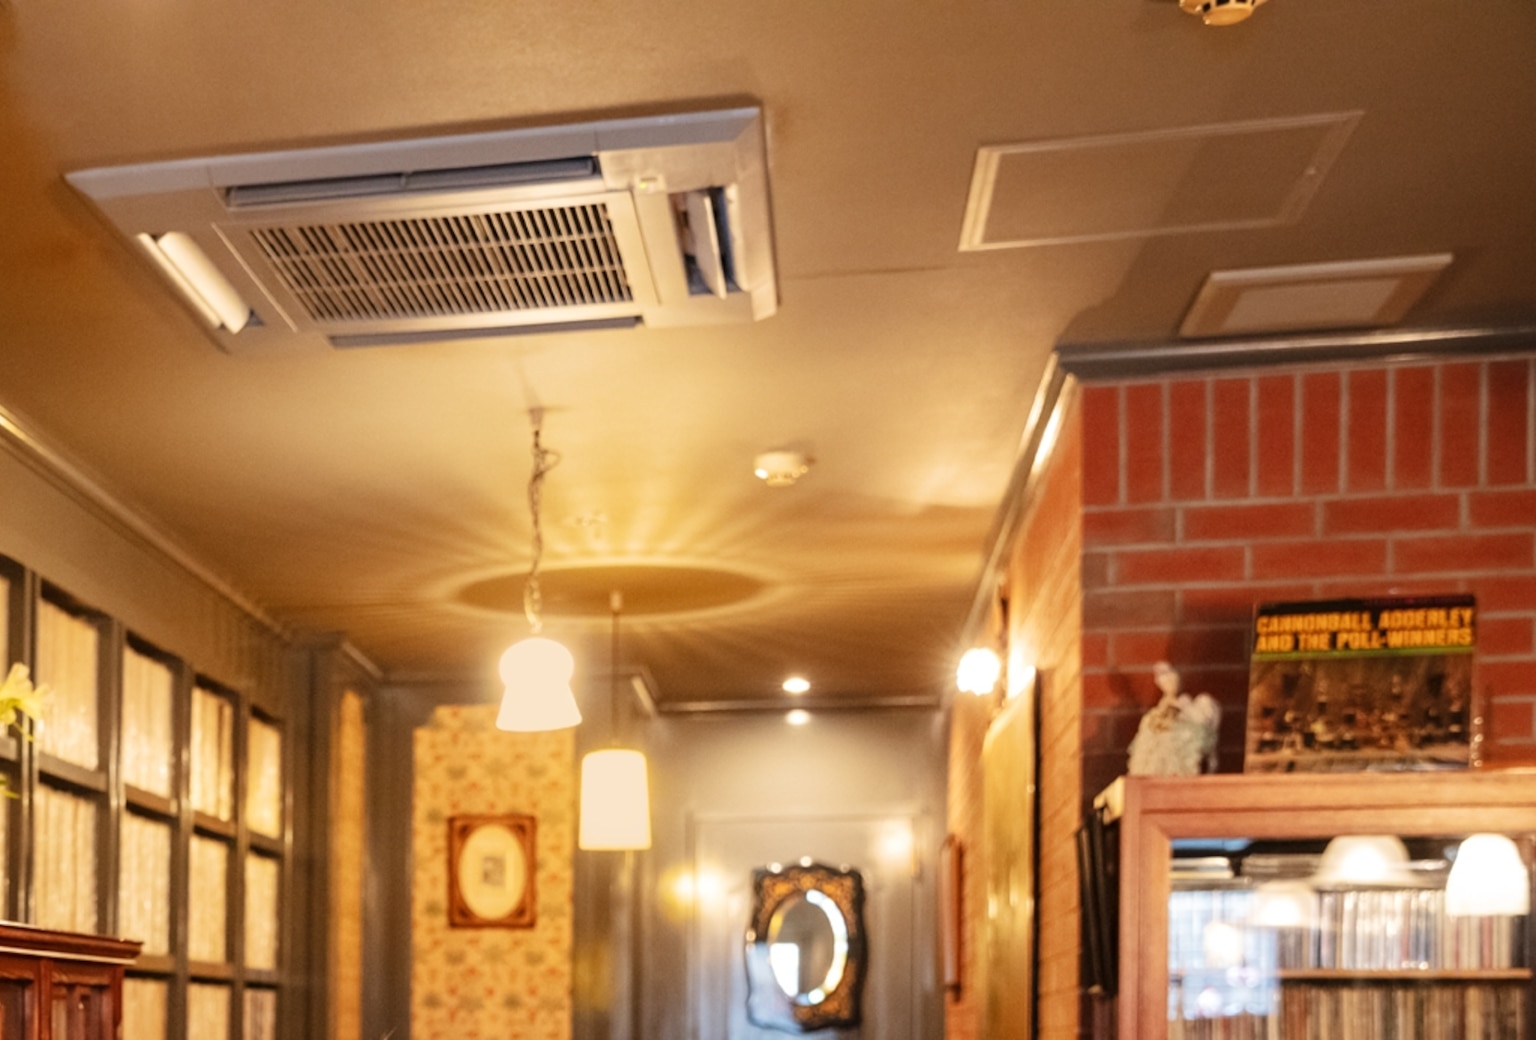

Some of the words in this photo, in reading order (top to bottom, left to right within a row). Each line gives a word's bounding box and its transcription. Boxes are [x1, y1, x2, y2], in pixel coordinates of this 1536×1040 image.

[1257, 612, 1371, 633] CANNONBALL
[1379, 607, 1473, 629] ADDERLEY
[1256, 633, 1295, 651] AND
[1299, 632, 1330, 650] THE
